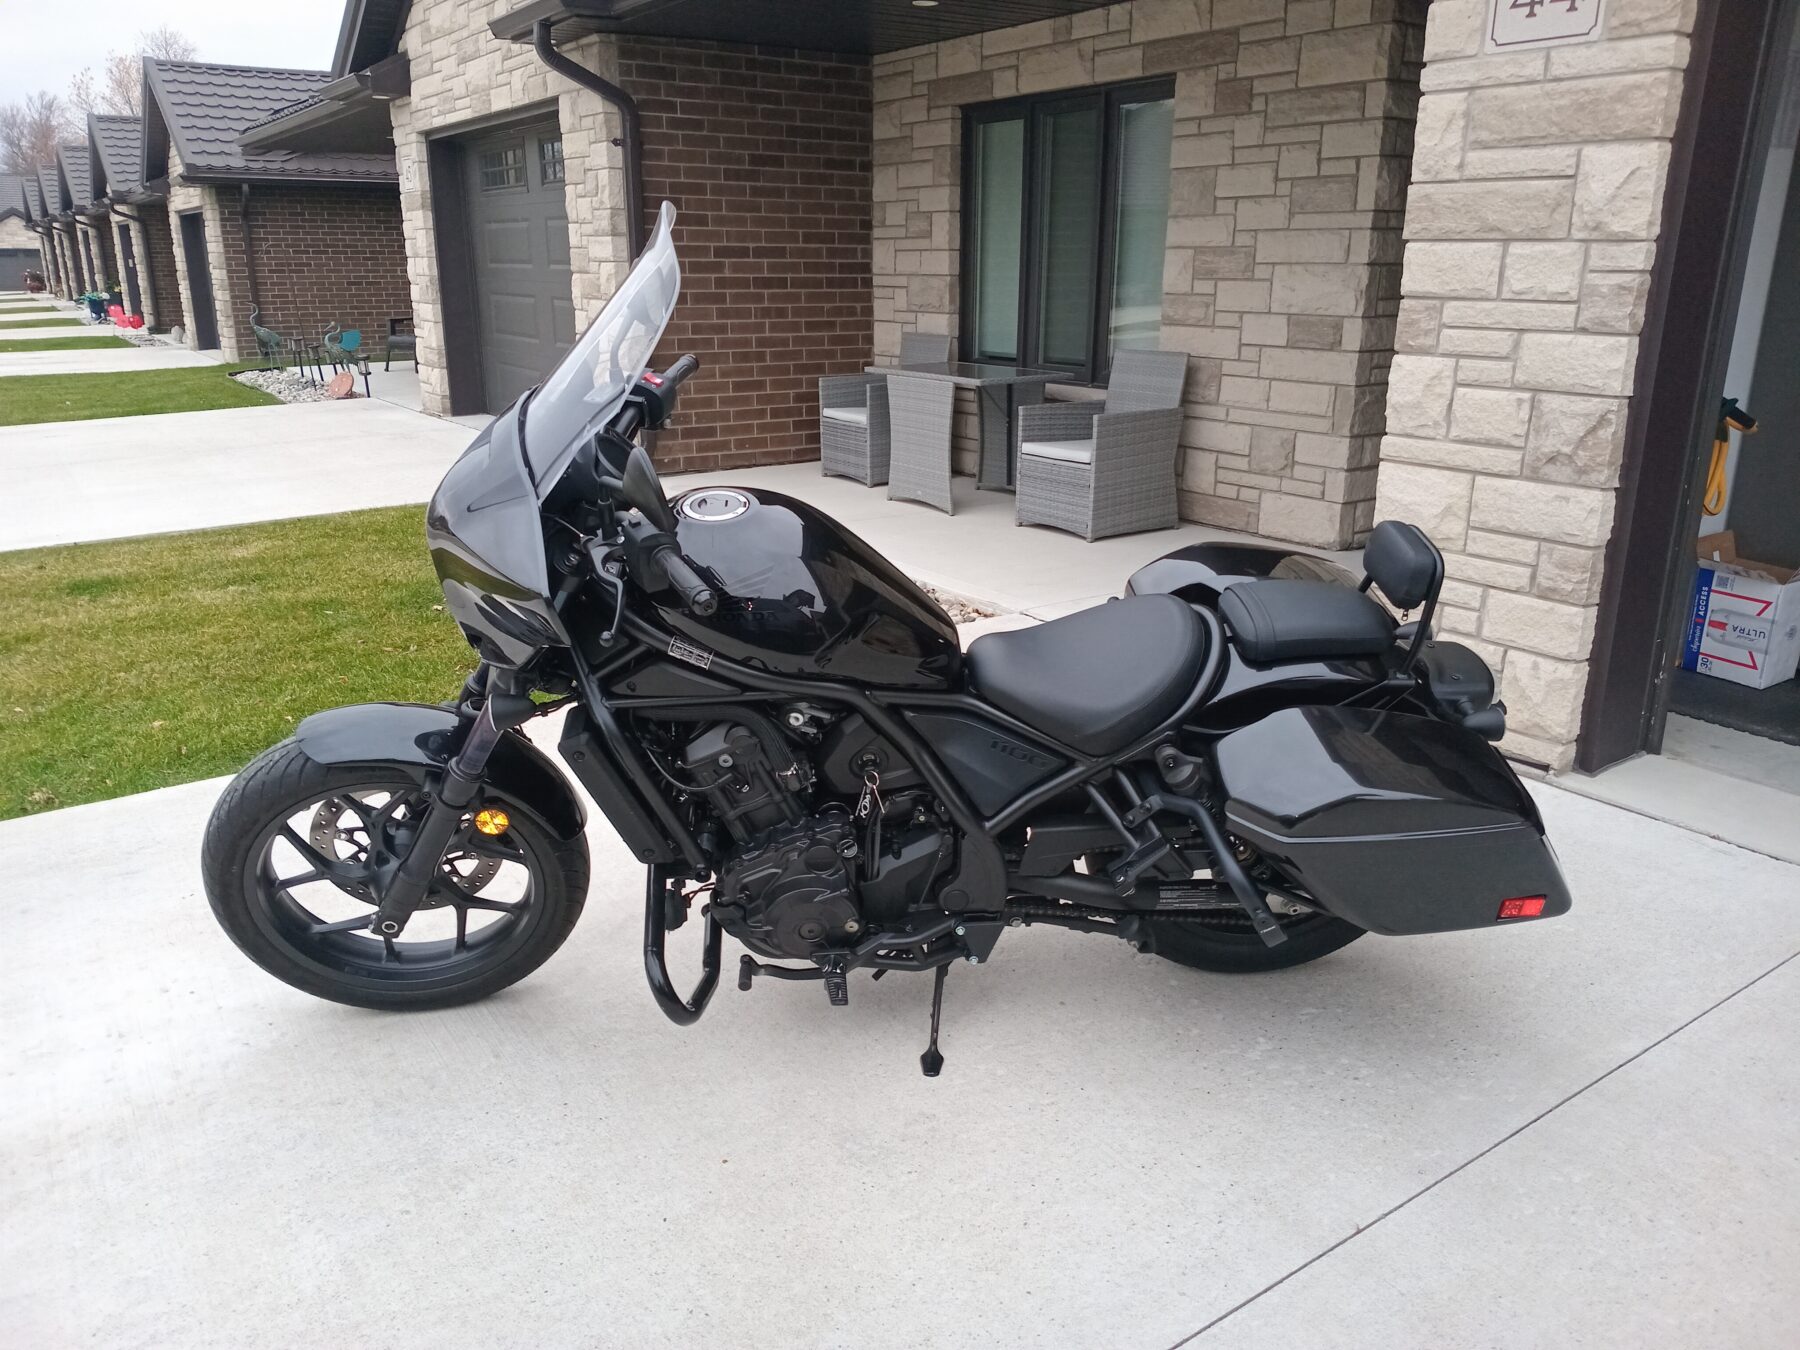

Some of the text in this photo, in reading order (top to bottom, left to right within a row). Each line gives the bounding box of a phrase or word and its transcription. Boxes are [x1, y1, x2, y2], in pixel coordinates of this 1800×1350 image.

[1698, 586, 1709, 616] ACCESS
[1731, 624, 1766, 639] ULTRA
[1700, 657, 1709, 669] 30
